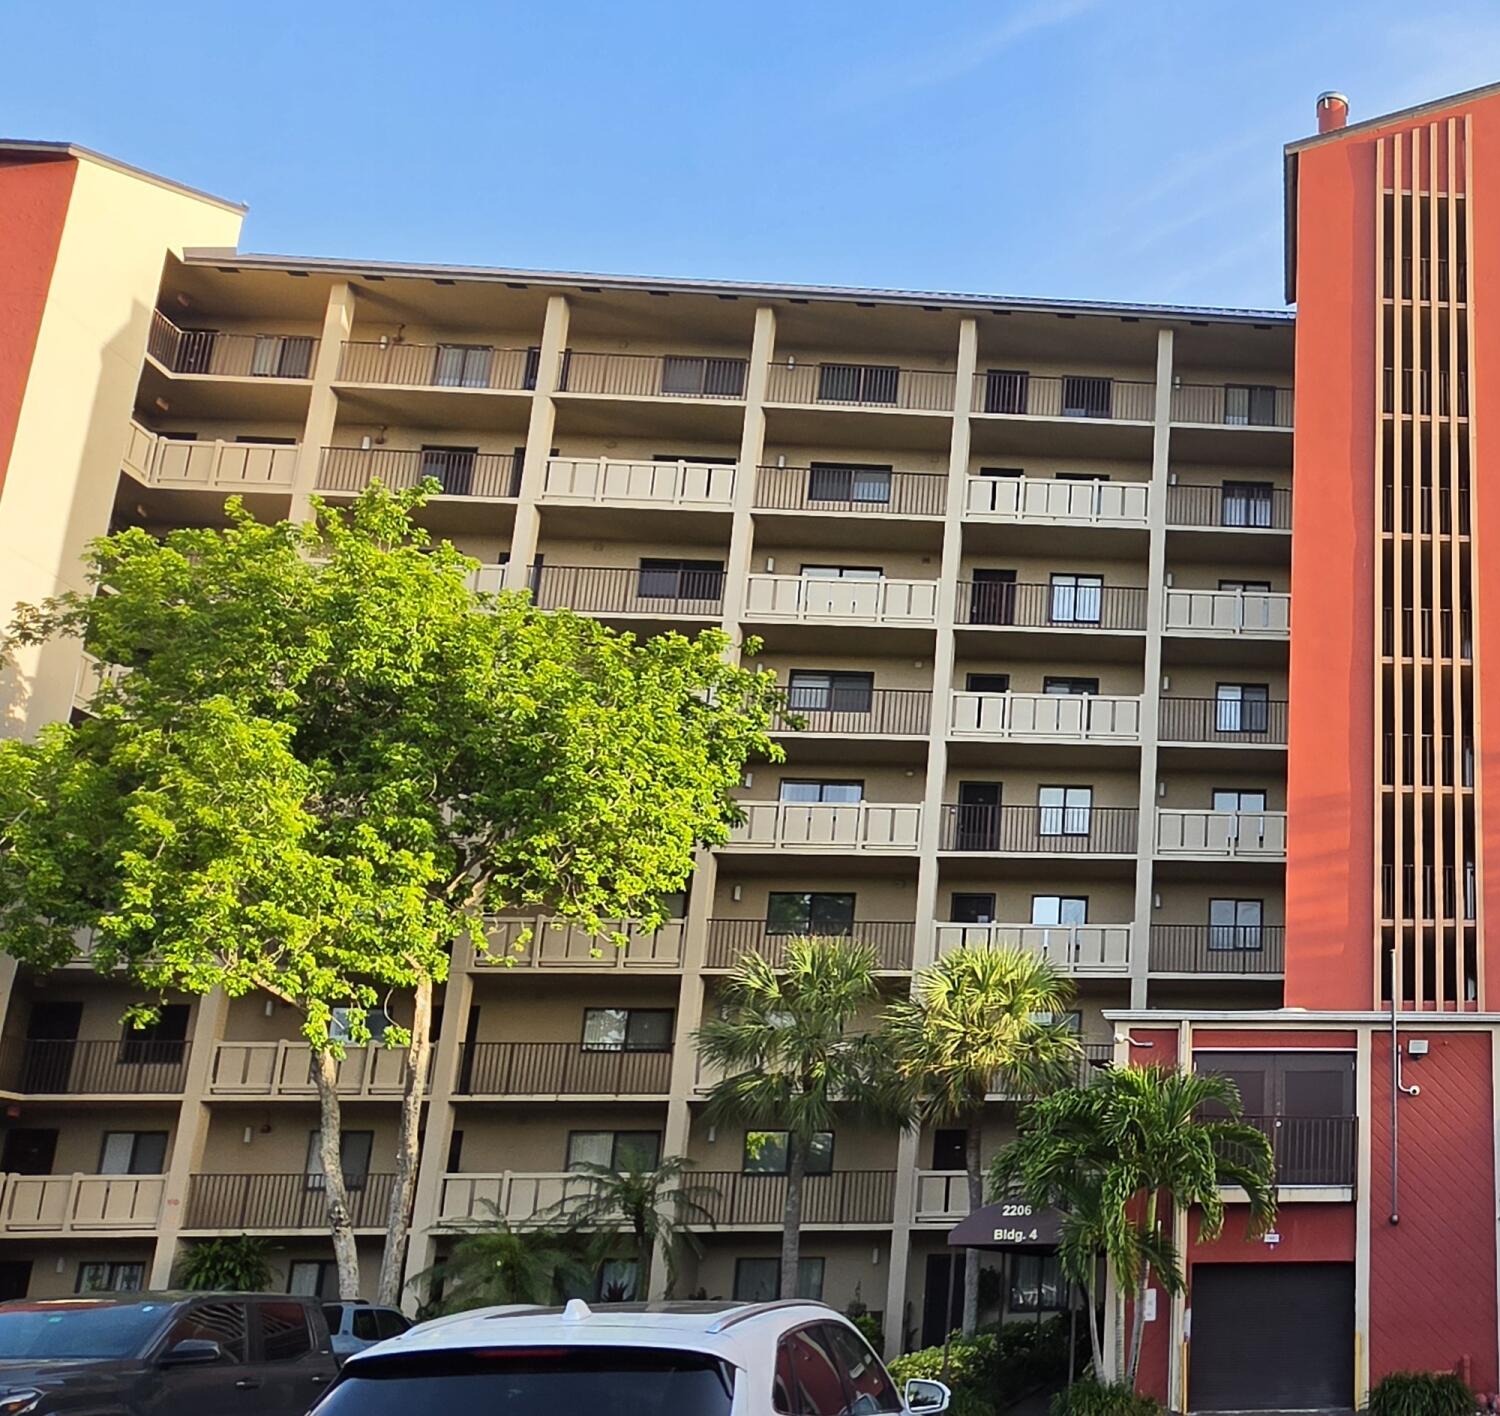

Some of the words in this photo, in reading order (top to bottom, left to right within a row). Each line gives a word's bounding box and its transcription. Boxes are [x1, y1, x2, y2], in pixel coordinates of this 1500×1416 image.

[1002, 1204, 1033, 1217] 2206
[993, 1228, 1027, 1243] Bldg.
[1028, 1228, 1039, 1240] 4
